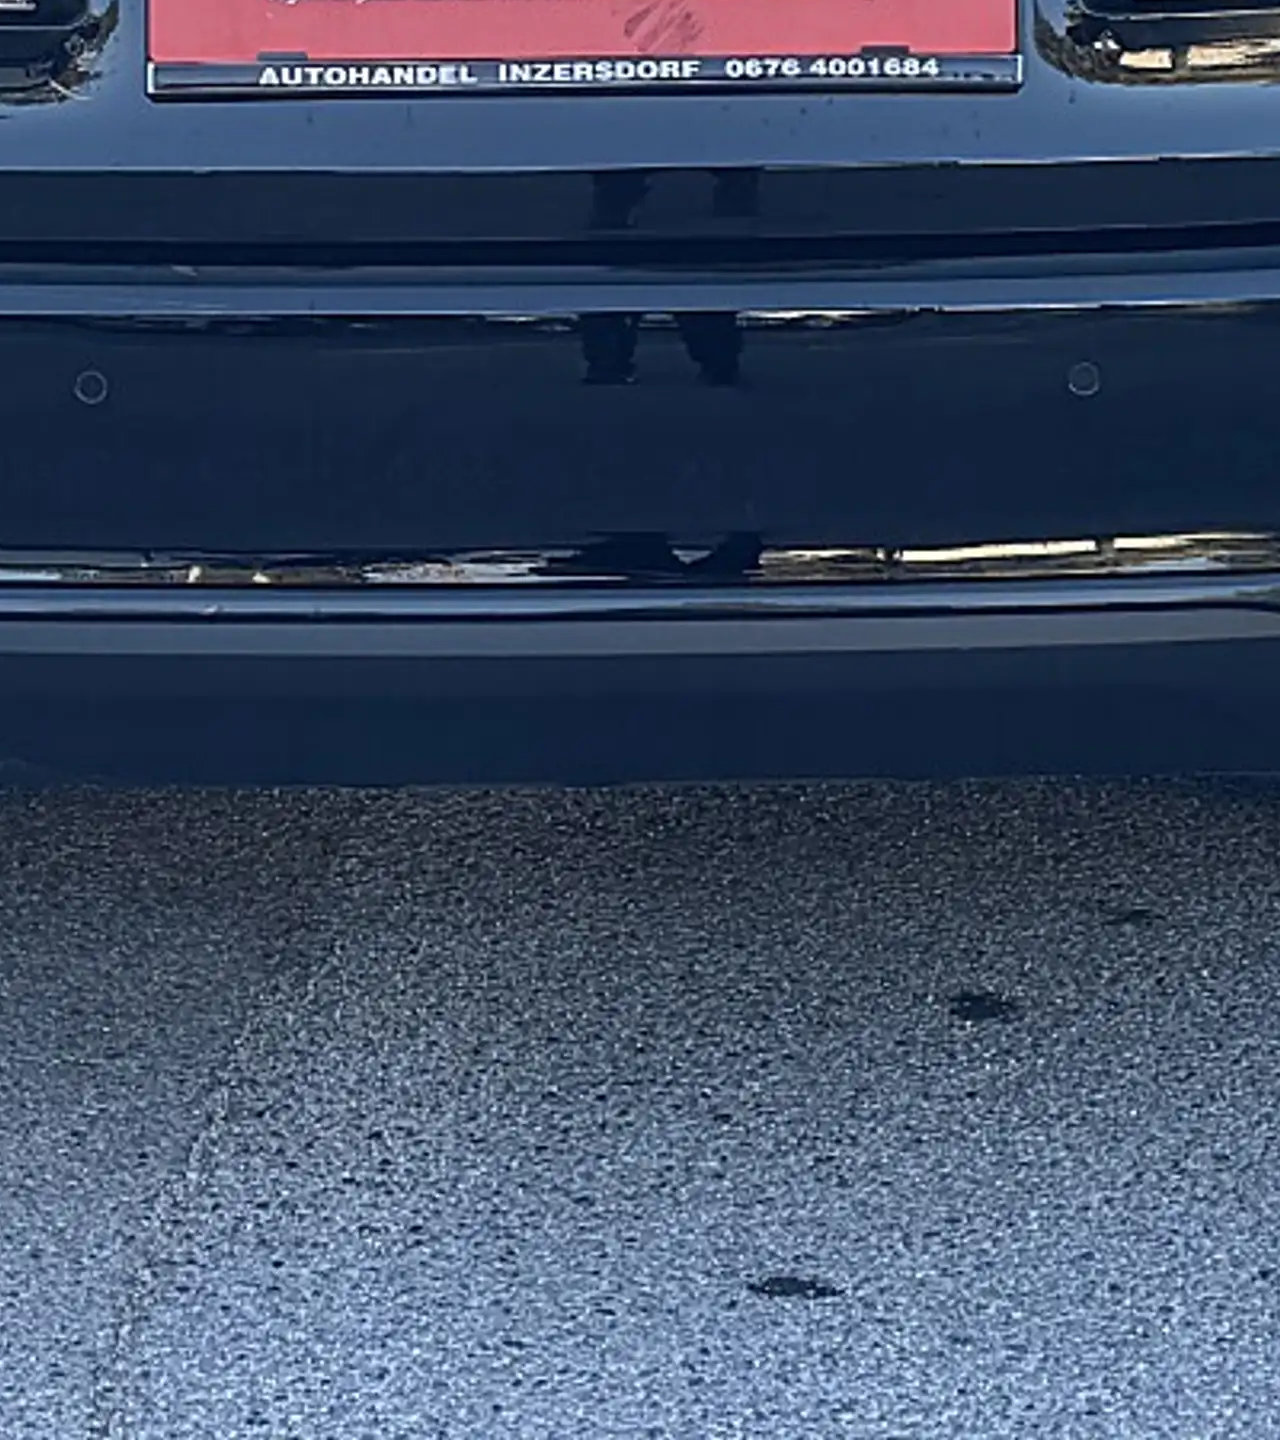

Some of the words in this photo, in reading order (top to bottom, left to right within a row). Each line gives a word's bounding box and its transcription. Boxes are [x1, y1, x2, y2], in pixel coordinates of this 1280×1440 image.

[259, 65, 478, 85] AUTOHANDEL
[498, 61, 700, 82] INZERSDORF
[725, 59, 800, 77] 0676
[810, 58, 940, 77] 4001684
